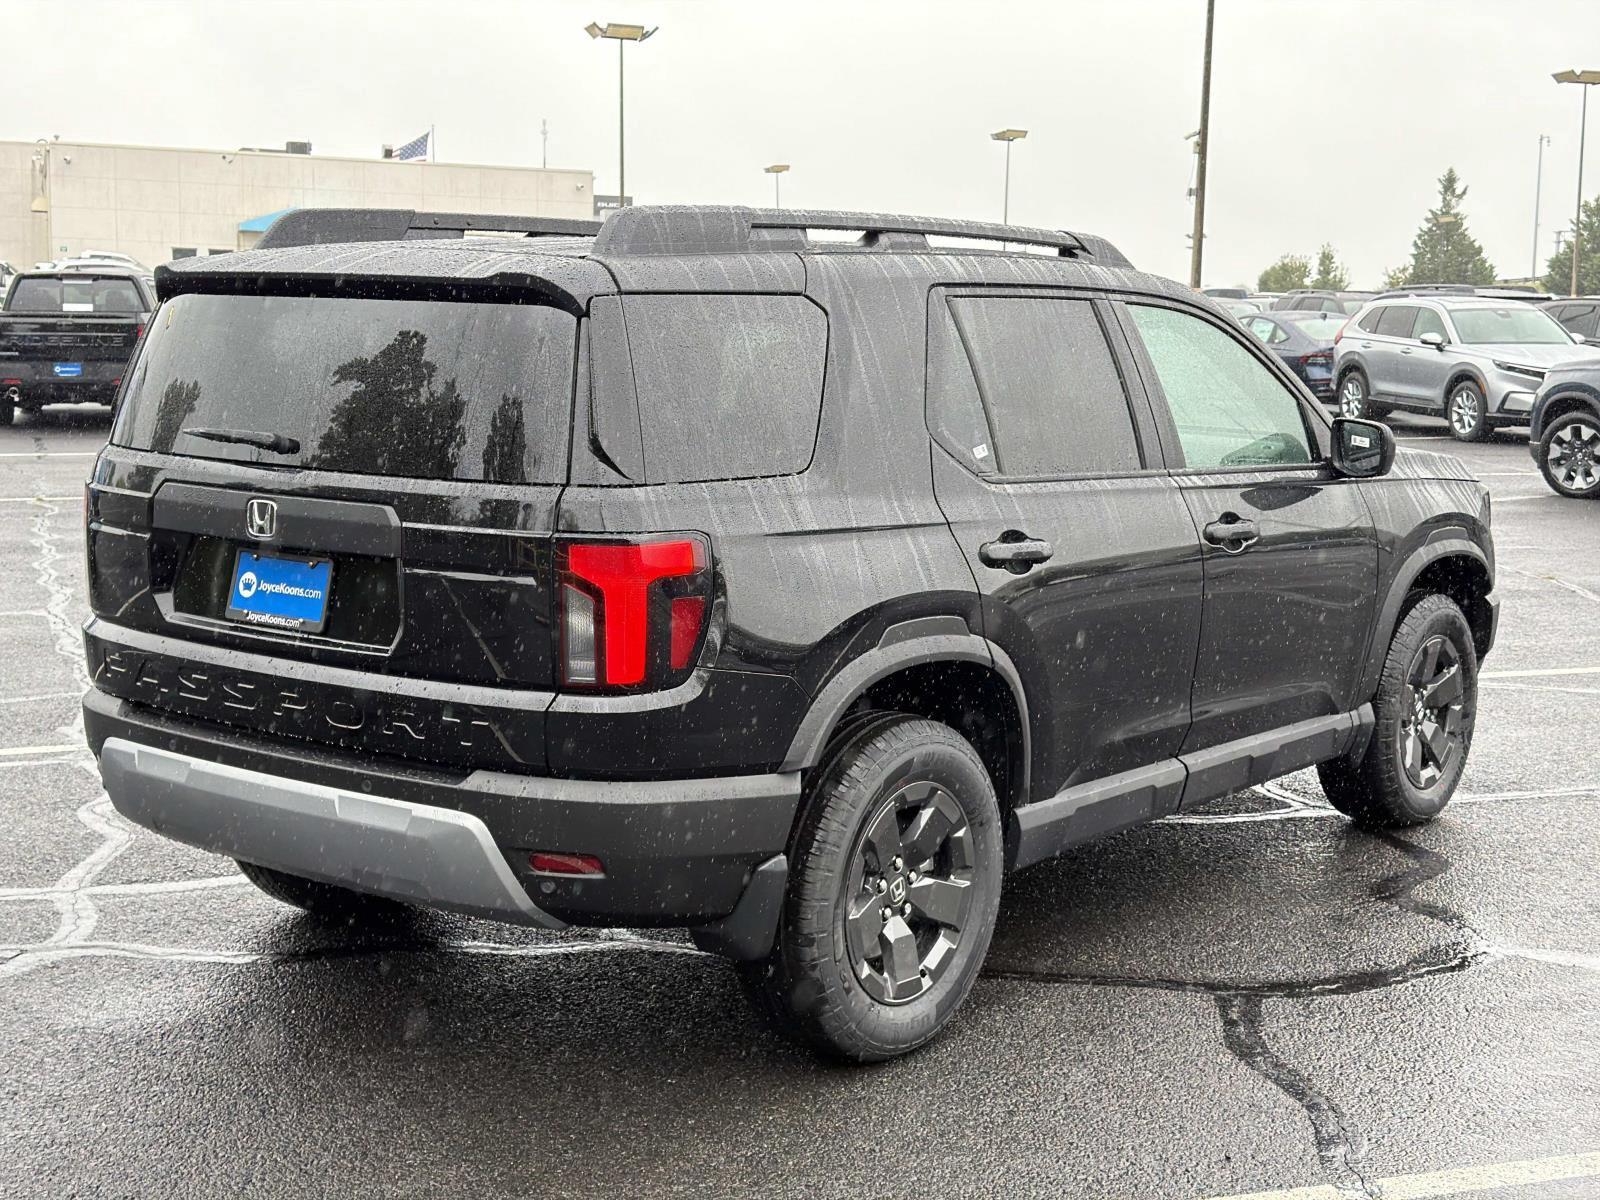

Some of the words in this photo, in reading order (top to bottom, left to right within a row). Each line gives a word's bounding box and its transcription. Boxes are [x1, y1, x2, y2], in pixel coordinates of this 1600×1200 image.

[257, 579, 322, 600] JoyceKoons.com
[246, 610, 301, 628] JoyceKoons.com
[104, 647, 491, 746] PASSPORT
